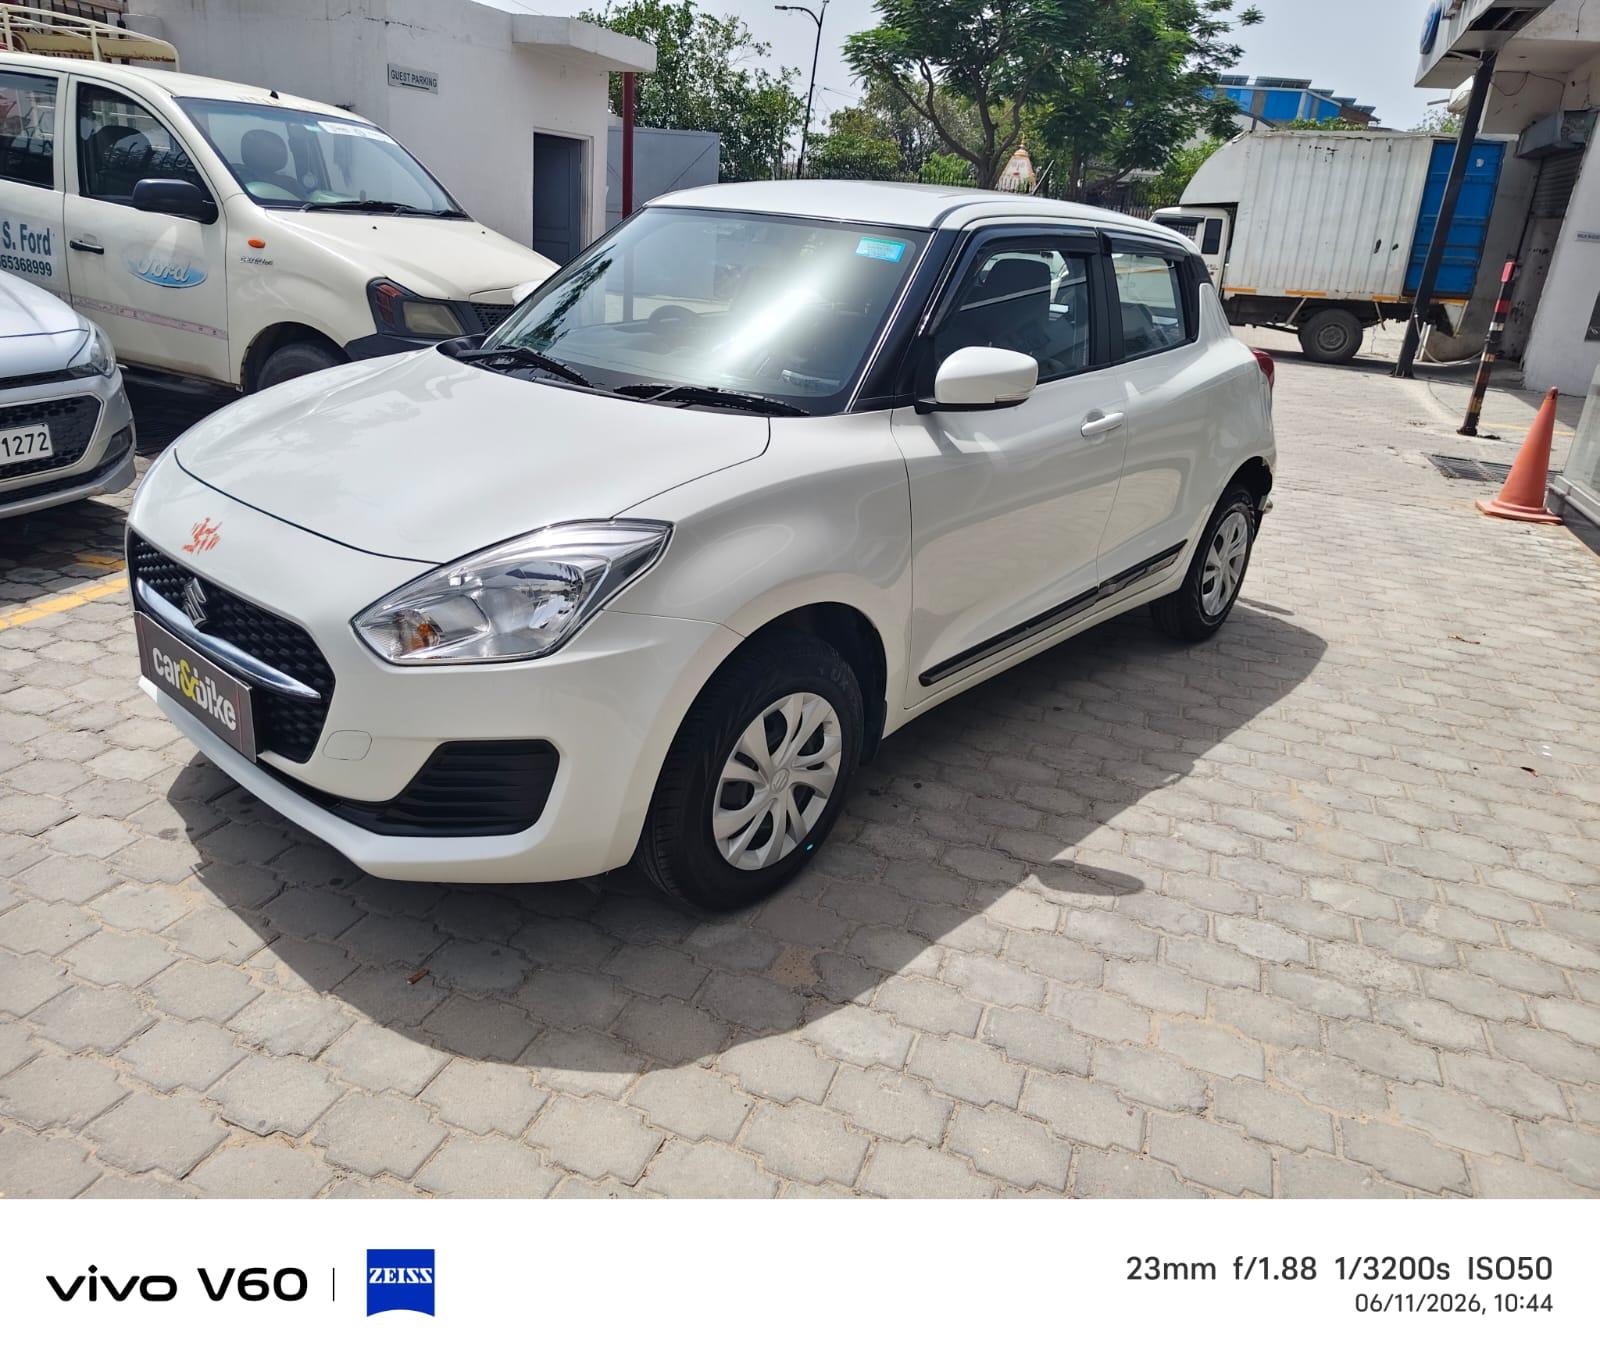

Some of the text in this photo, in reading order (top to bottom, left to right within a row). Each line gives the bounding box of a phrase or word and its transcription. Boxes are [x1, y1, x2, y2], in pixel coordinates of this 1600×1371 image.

[391, 70, 437, 88] GUEST PARKING
[2, 221, 52, 256] S. Ford
[0, 254, 53, 277] 65368999
[1, 431, 49, 457] 1272
